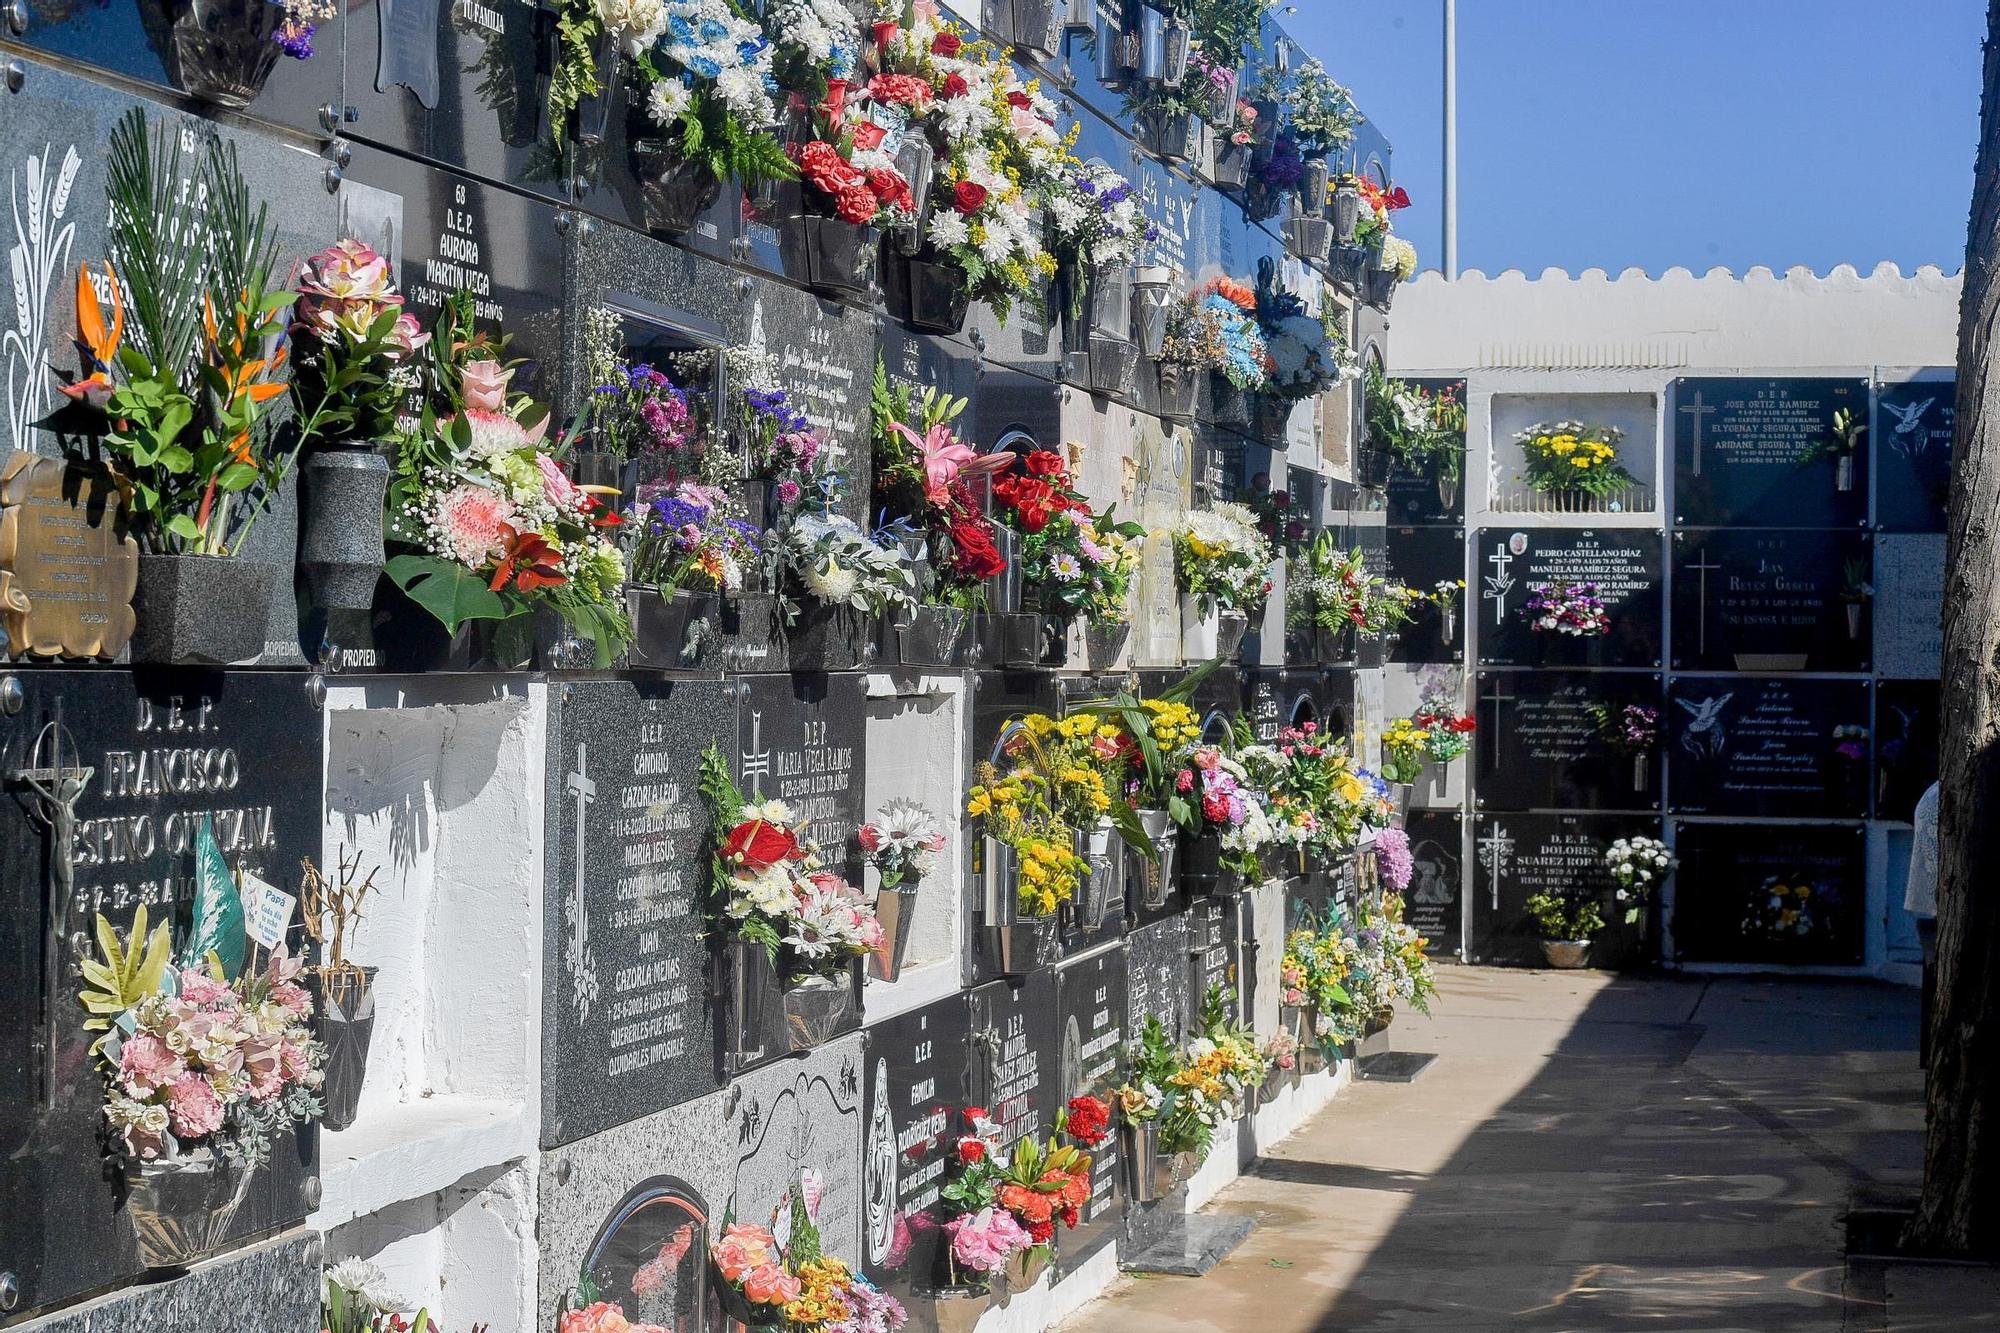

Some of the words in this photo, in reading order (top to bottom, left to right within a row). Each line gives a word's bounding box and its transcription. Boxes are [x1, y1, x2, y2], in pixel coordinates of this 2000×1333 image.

[474, 3, 504, 35] FAMILIA
[181, 128, 194, 154] 63
[455, 184, 466, 205] 68
[440, 233, 479, 265] AURORA
[426, 258, 464, 290] MARTÍN
[466, 271, 490, 297] VEGA
[475, 301, 484, 318] 89
[484, 299, 503, 322] AÑOS
[1763, 424, 1796, 432] SEGURA
[1758, 441, 1791, 449] SEGURA
[1535, 549, 1563, 557] PEDRO
[1564, 549, 1620, 557] CASTELLANO
[1621, 547, 1641, 557] DÍAZ
[1530, 565, 1572, 573] MANUELA
[1572, 564, 1611, 573] RAMÍREZ
[1611, 565, 1646, 573] SEGURA
[1526, 581, 1554, 589] PEDRO
[1611, 579, 1650, 589] RAMÍREZ
[264, 640, 300, 658] ROPIEDAD
[103, 747, 240, 799] FRANCISCO
[634, 749, 669, 776] CÁNDIDO
[777, 750, 802, 776] MARIA
[805, 748, 826, 773] VEGA
[827, 747, 852, 771] RAMOS
[621, 784, 658, 809] CAZORLA
[660, 778, 679, 805] LEÓN
[625, 838, 651, 867] MARÍA
[652, 835, 675, 863] JESÚS
[1516, 856, 1564, 866] SUAREZ
[1540, 845, 1598, 855] DOLORES
[265, 889, 286, 907] Papá
[639, 930, 659, 956] JUAN
[616, 964, 652, 992] CAZORLA
[653, 955, 680, 984] MEJÍAS
[663, 1010, 683, 1034] FÁCIL
[609, 1048, 649, 1077] OLVIDARLES
[650, 1036, 684, 1065] IMPOSIBLE
[911, 1076, 935, 1106] FAMILIA
